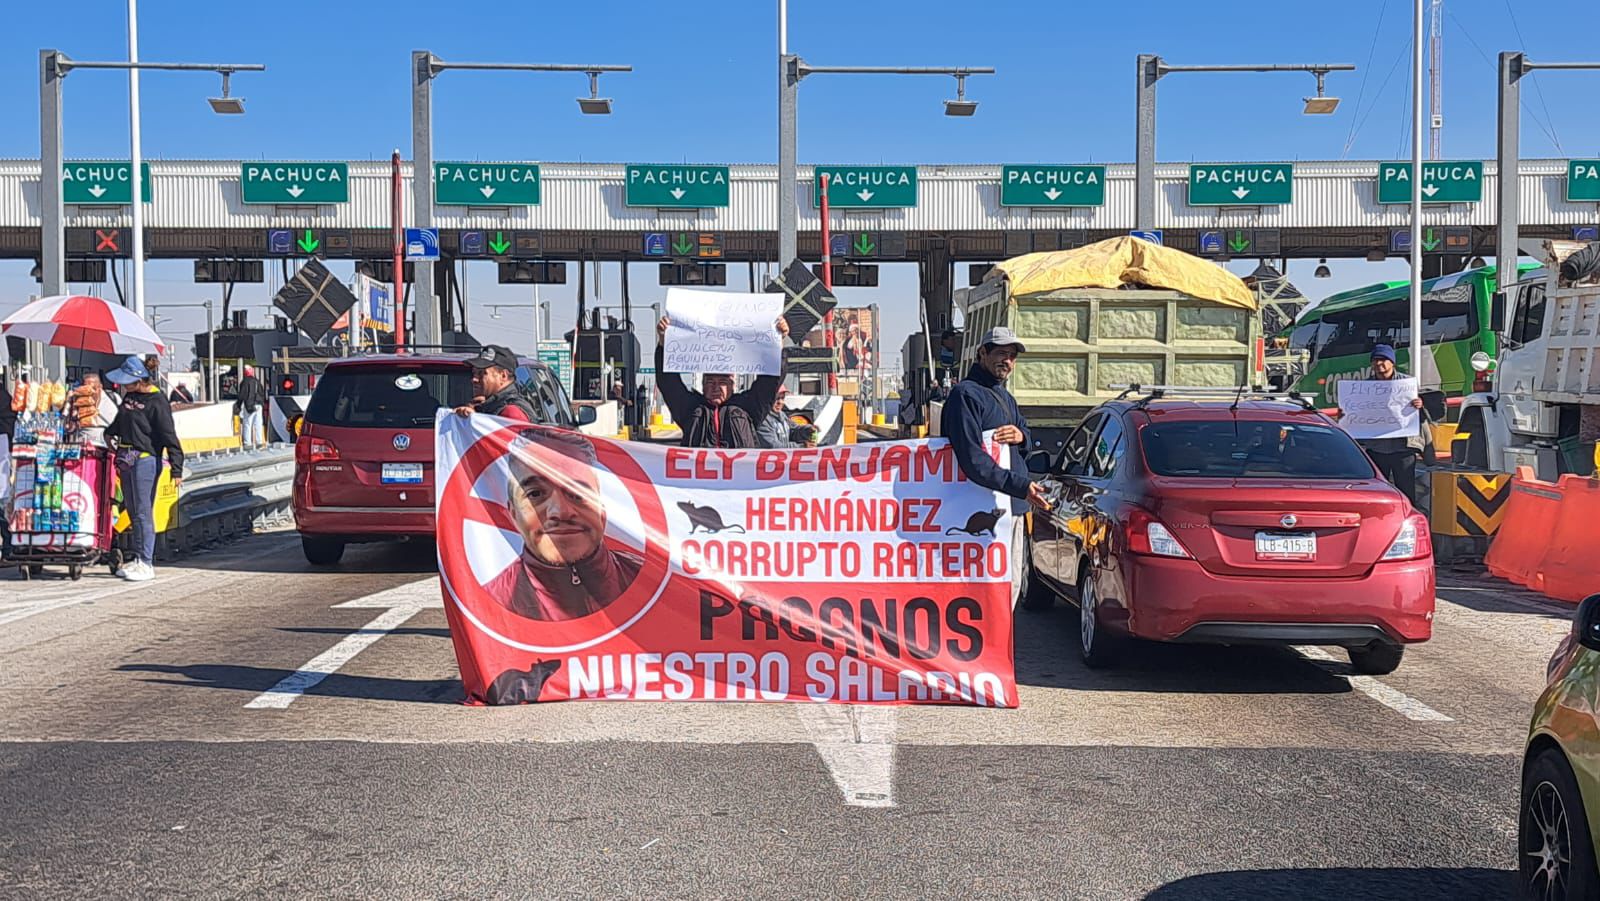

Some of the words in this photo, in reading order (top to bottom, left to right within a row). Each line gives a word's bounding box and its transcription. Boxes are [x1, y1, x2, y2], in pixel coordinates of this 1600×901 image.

[62, 167, 142, 181] ACHUC
[248, 167, 341, 182] PACHUCA
[439, 167, 536, 183] PACHUCA
[630, 170, 725, 185] PACHUCA
[1008, 171, 1098, 185] PACHUCA
[1195, 169, 1286, 183] PACHUCA
[1385, 167, 1476, 181] PAHUCA
[666, 341, 736, 353] QUINCENA
[665, 447, 747, 481] ELY
[745, 490, 942, 533] HERNÁNDEZ
[1256, 539, 1314, 553] LLB-415-B
[681, 540, 864, 578] CORRUPTO
[872, 541, 1008, 579] RATERO
[699, 588, 984, 662] PAGANOS
[567, 651, 790, 701] NUESTRO
